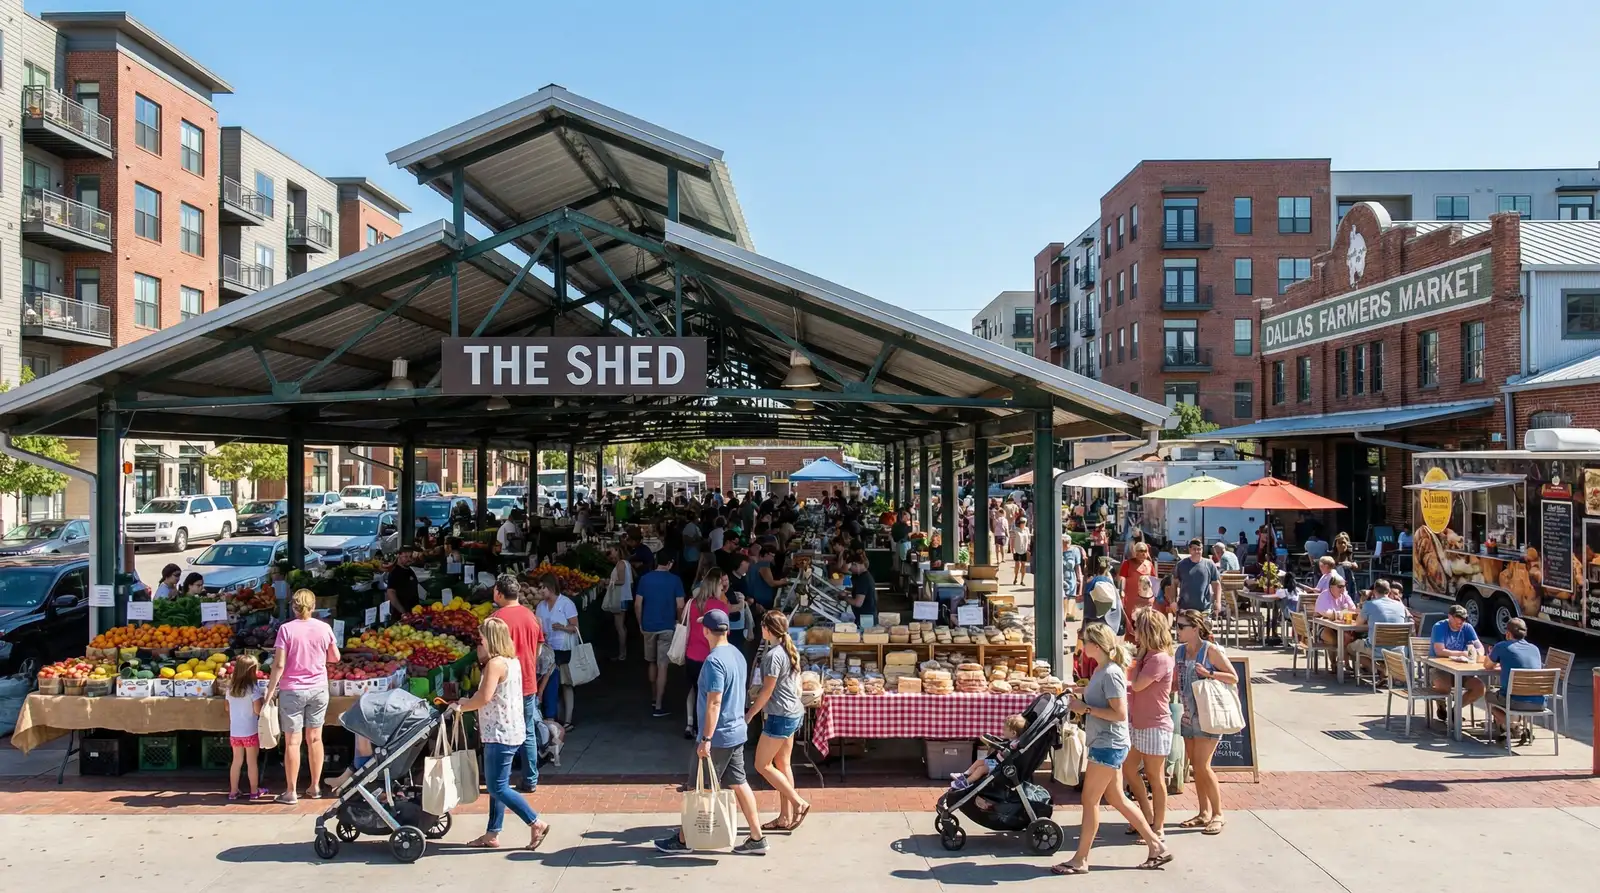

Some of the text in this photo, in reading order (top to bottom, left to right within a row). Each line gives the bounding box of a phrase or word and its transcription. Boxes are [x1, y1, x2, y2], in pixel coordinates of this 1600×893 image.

[1266, 263, 1482, 347] DALLAS FARMERS MARKET
[464, 344, 686, 386] THE SHED
